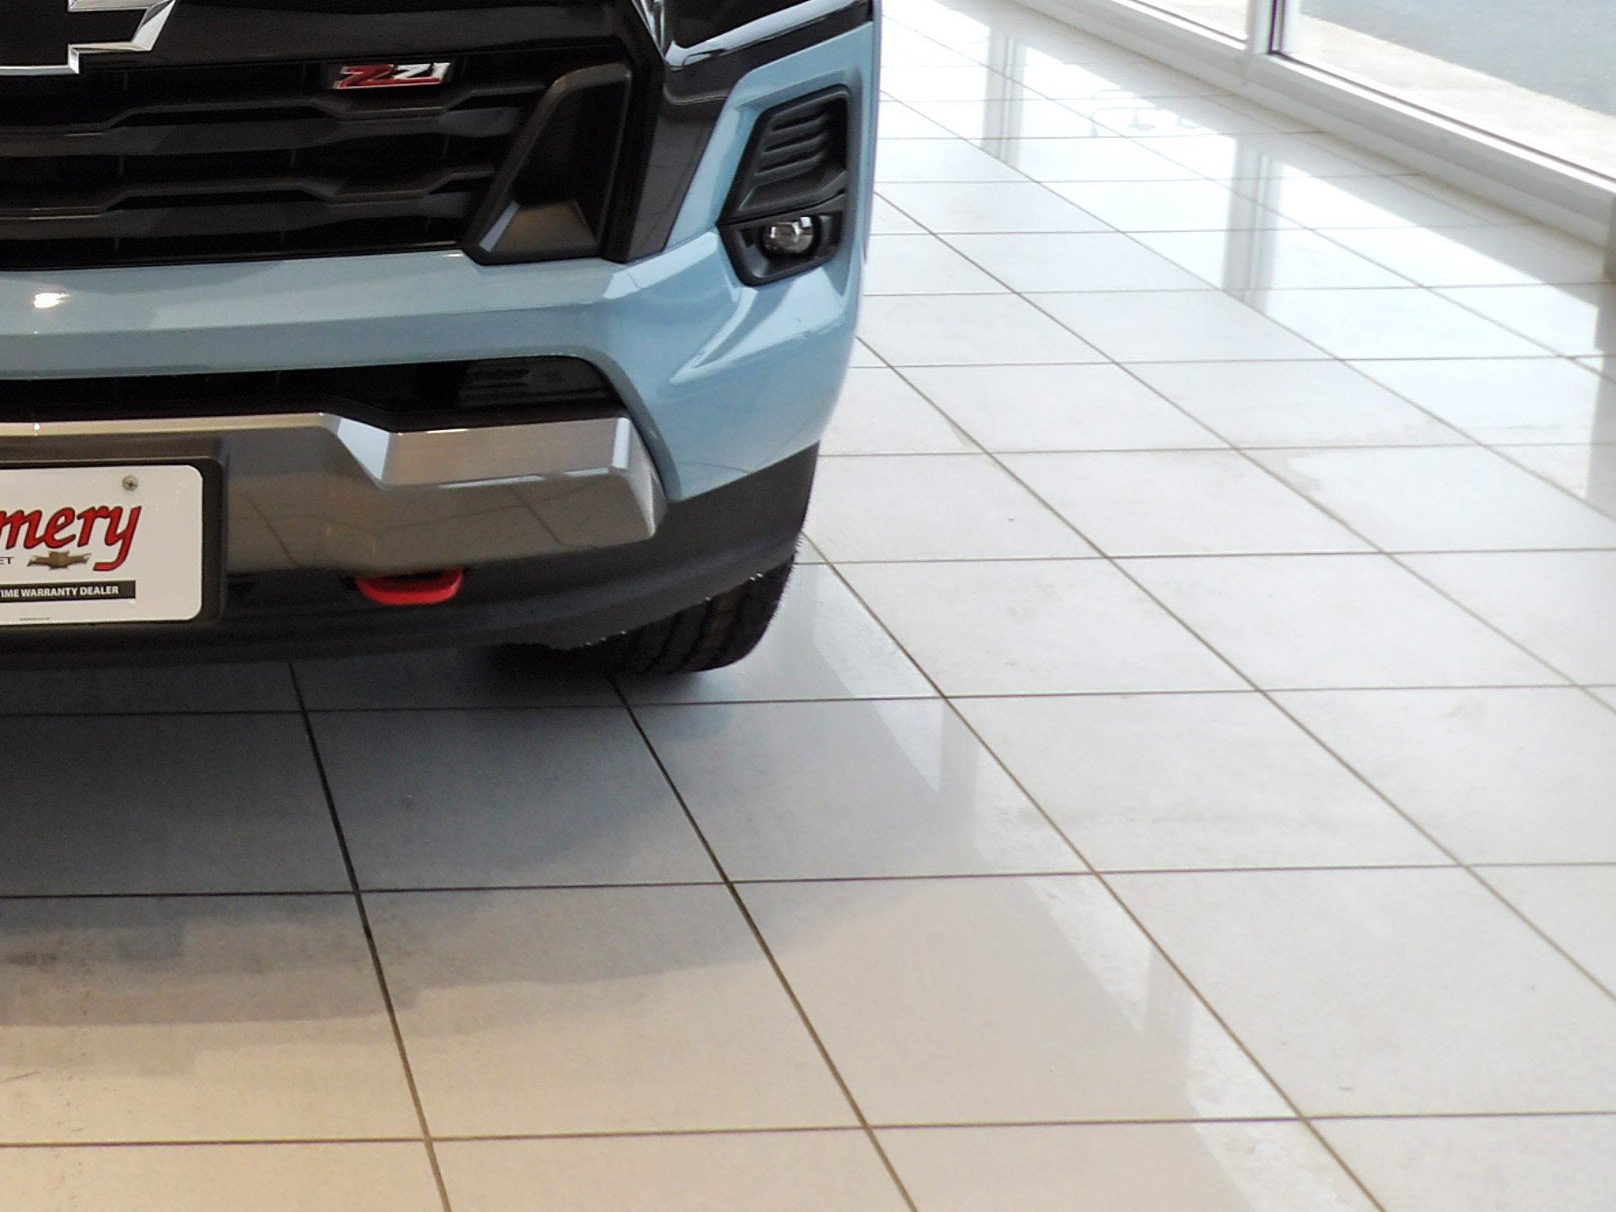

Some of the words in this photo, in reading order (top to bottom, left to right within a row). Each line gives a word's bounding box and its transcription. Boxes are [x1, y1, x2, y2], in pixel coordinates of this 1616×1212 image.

[333, 63, 451, 90] Z71
[21, 586, 77, 597] WARRANTY
[79, 585, 119, 595] DEALER
